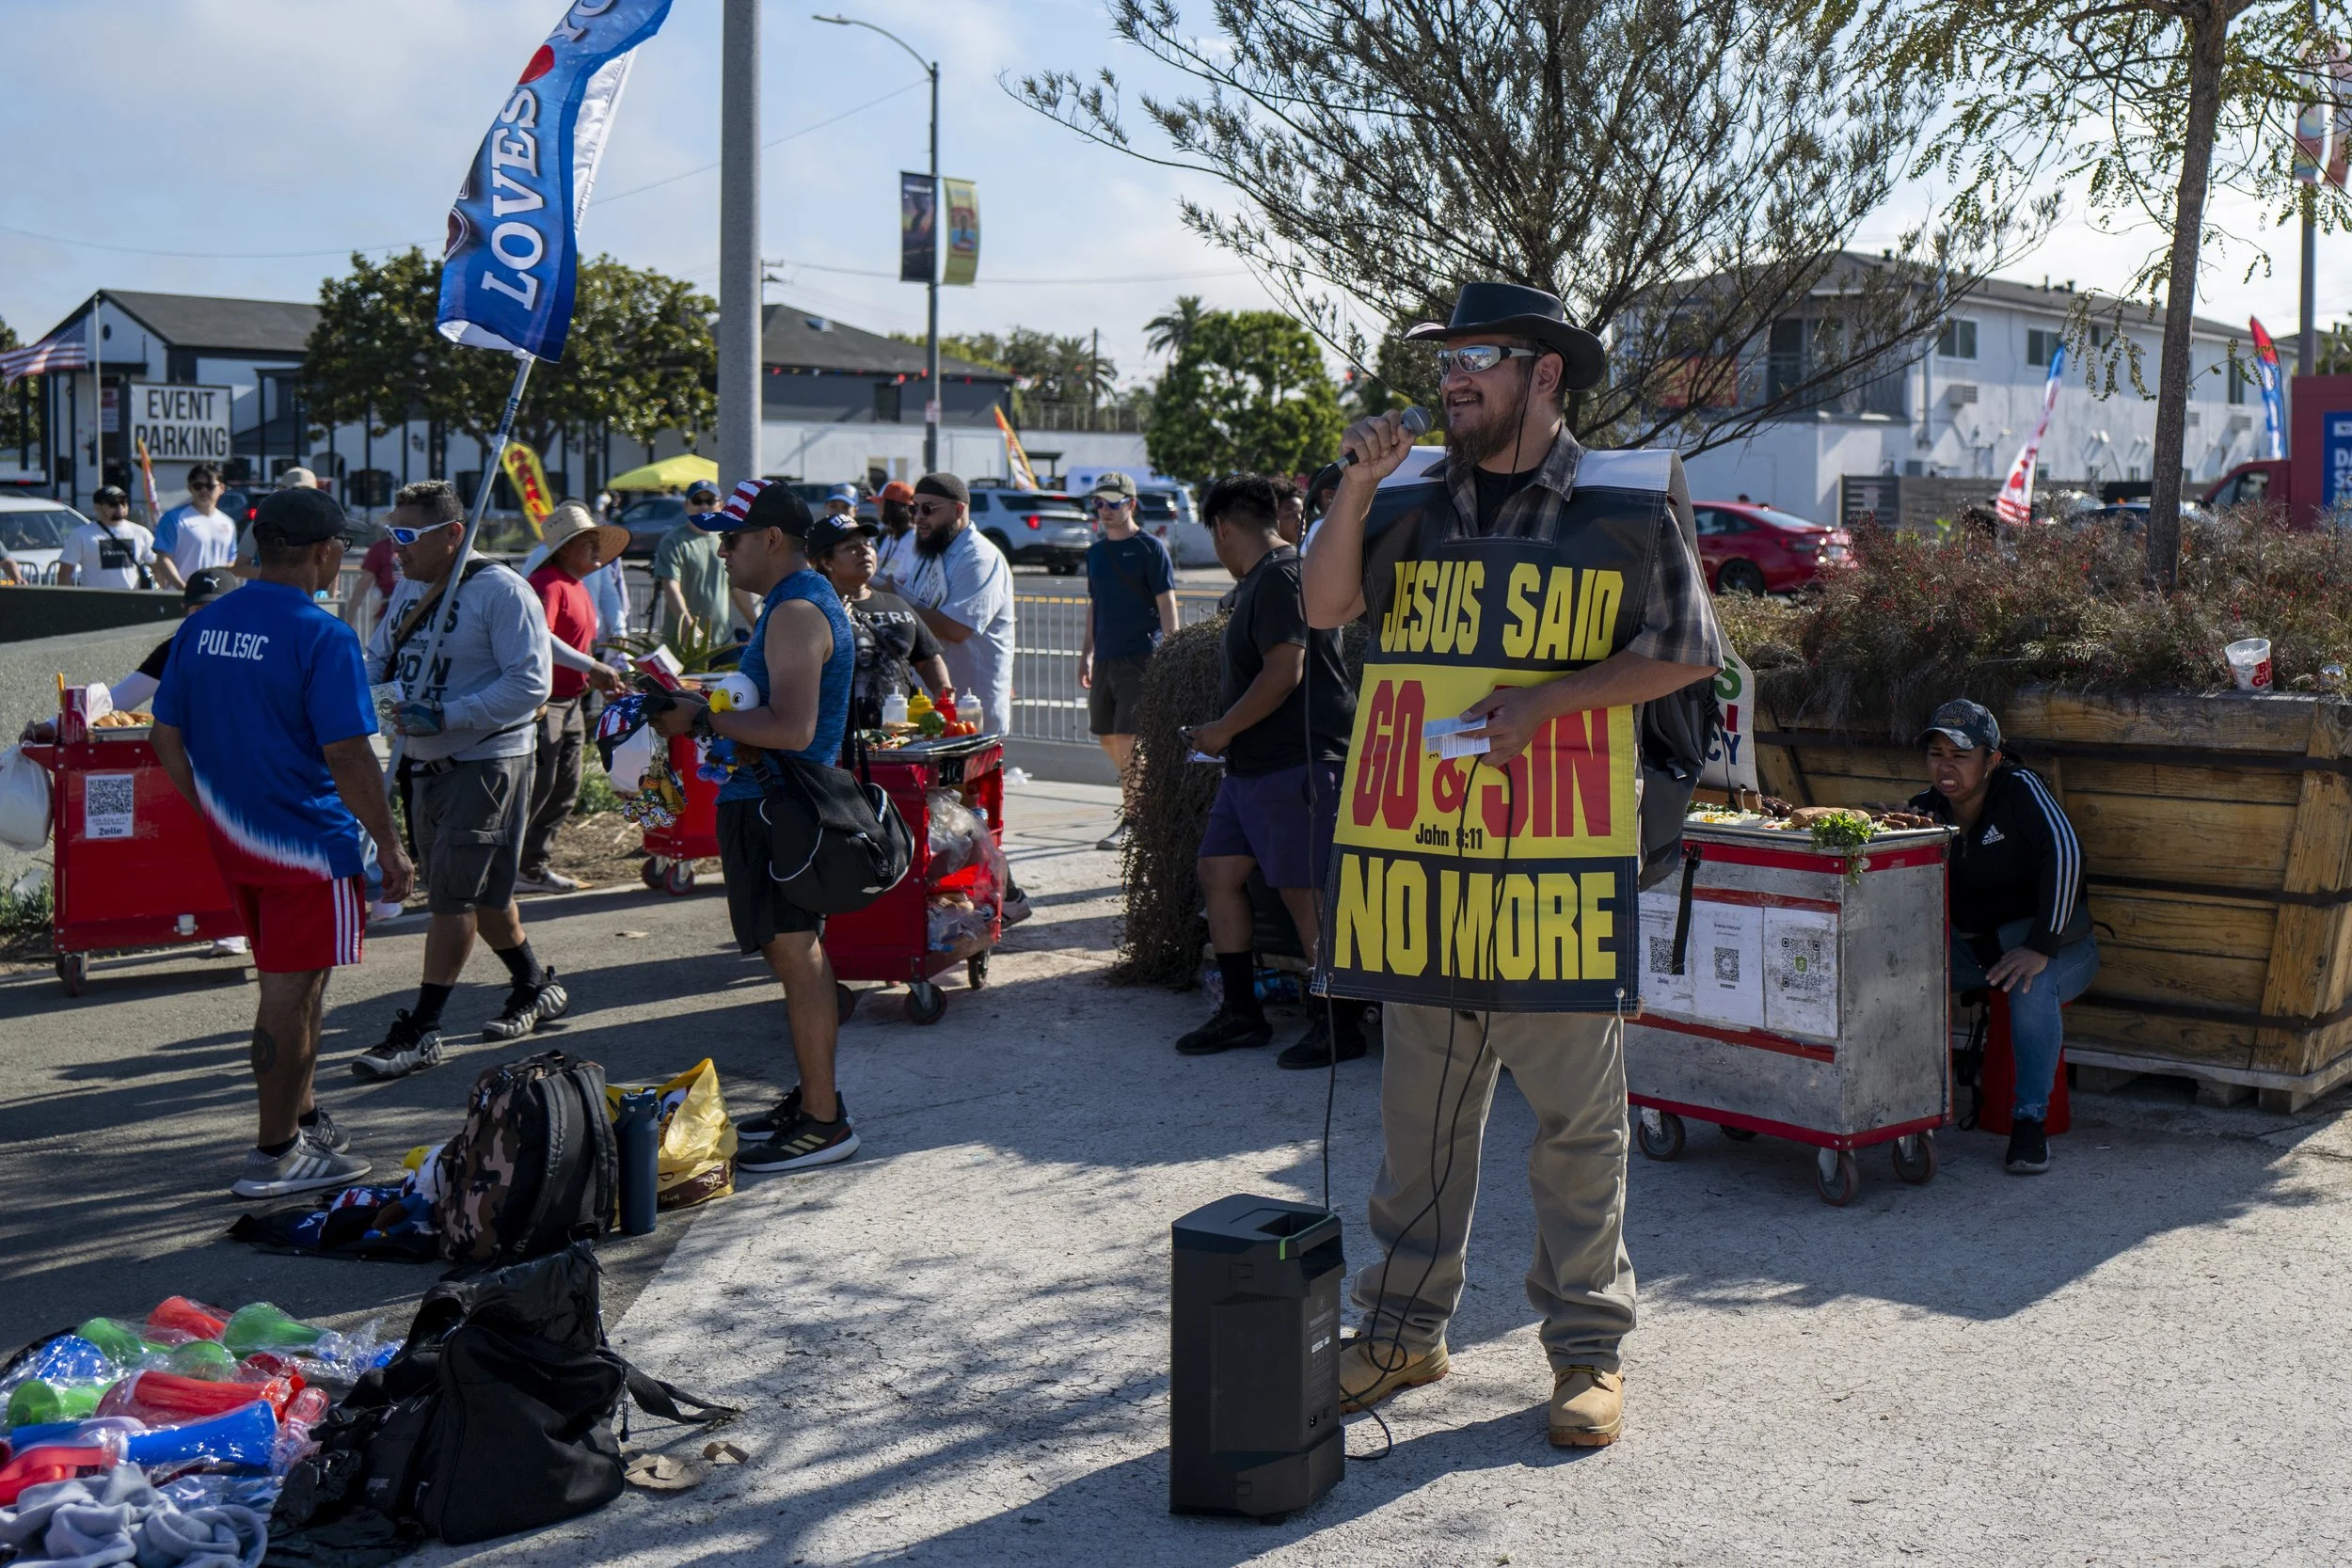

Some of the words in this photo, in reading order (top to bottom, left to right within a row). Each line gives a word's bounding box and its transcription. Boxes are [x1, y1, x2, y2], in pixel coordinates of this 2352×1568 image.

[481, 88, 544, 311] LOVES
[148, 389, 215, 420] EVENT
[135, 424, 227, 457] PARKING
[1380, 561, 1485, 655] JESUS
[1502, 562, 1624, 660] SAID
[1352, 680, 1425, 830] GO
[98, 827, 122, 836] Zelle
[1415, 823, 1449, 847] John
[1981, 833, 2005, 846] adidas
[1334, 853, 1428, 977] NO
[1440, 870, 1617, 981] MORE
